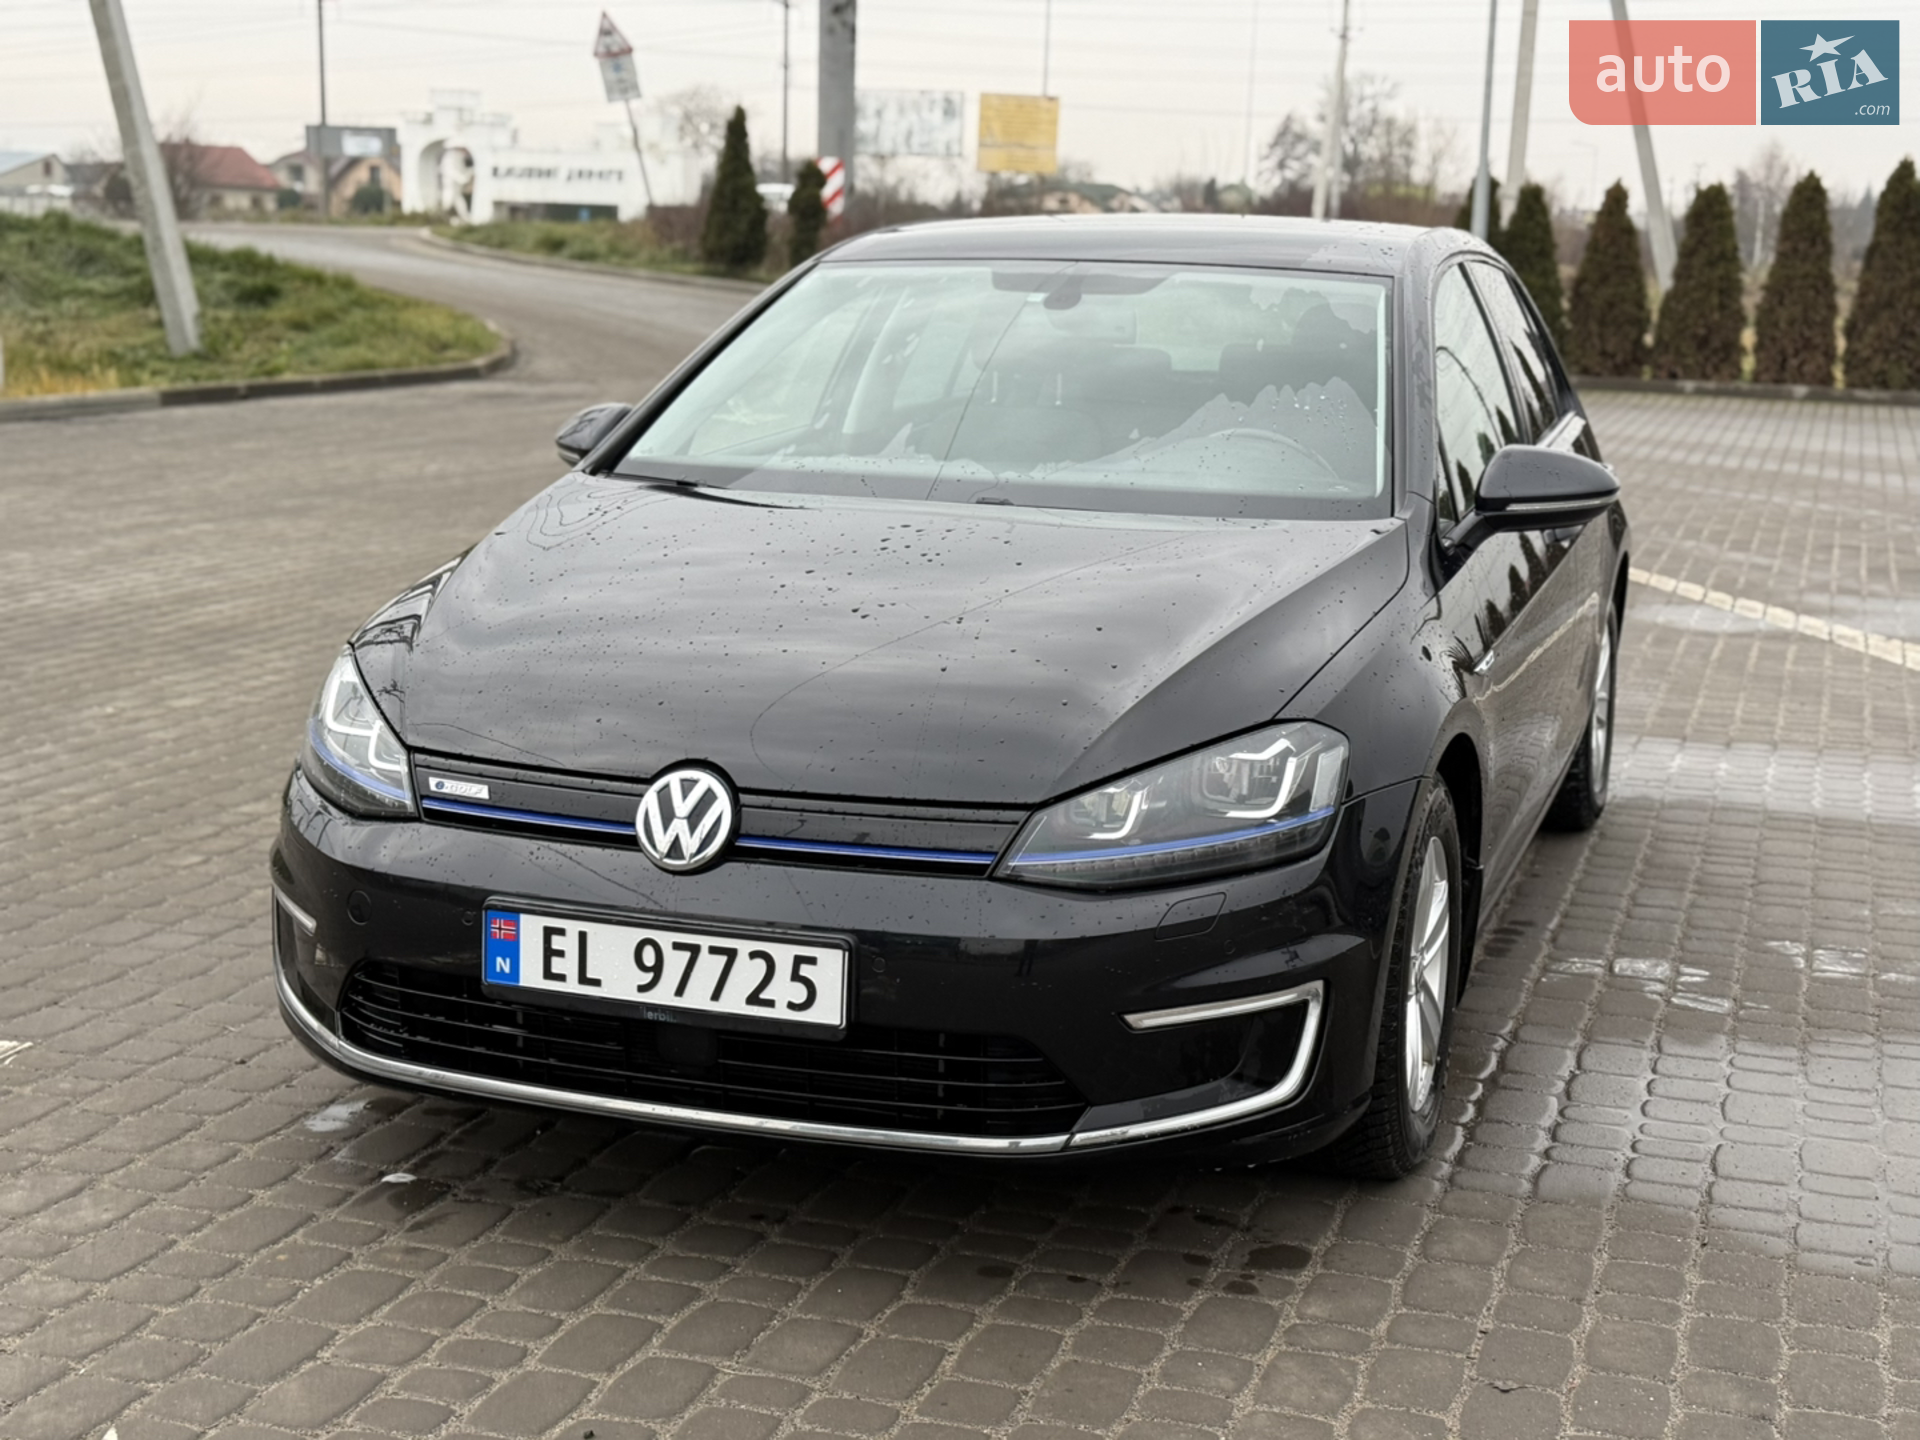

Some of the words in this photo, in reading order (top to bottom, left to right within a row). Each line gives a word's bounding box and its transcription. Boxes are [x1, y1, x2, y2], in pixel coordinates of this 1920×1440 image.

[639, 770, 729, 866] VW
[496, 956, 511, 974] N
[542, 925, 602, 988] EL
[633, 937, 818, 1012] 97725
